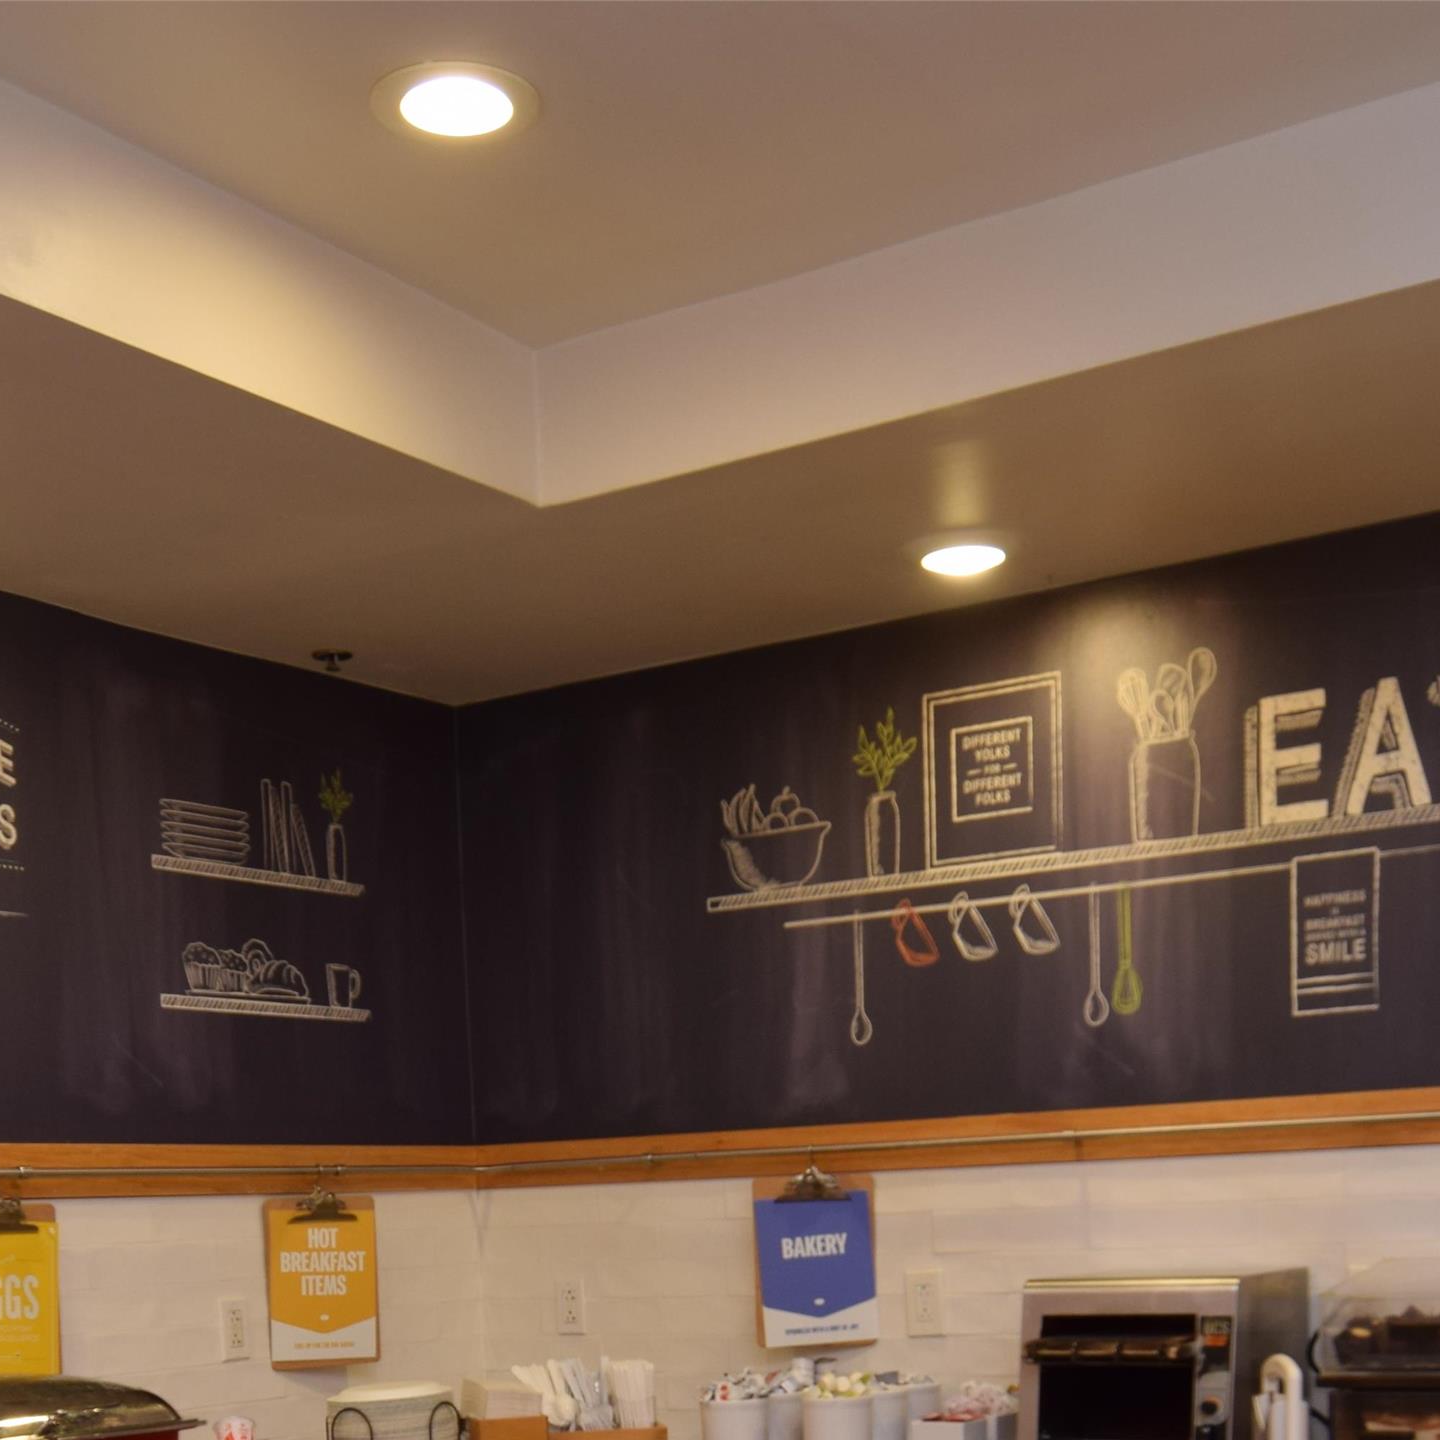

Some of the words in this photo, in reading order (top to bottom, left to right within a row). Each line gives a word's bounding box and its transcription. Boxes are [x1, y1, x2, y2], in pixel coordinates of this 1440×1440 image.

[962, 727, 1022, 750] DIFFERENT
[962, 772, 1022, 794] DIFFERENT
[1305, 937, 1367, 966] SMILE
[308, 1227, 338, 1249] HOT
[781, 1232, 848, 1260] BAKERY
[280, 1251, 366, 1273] BREAKFAST
[301, 1275, 347, 1296] ITEMS
